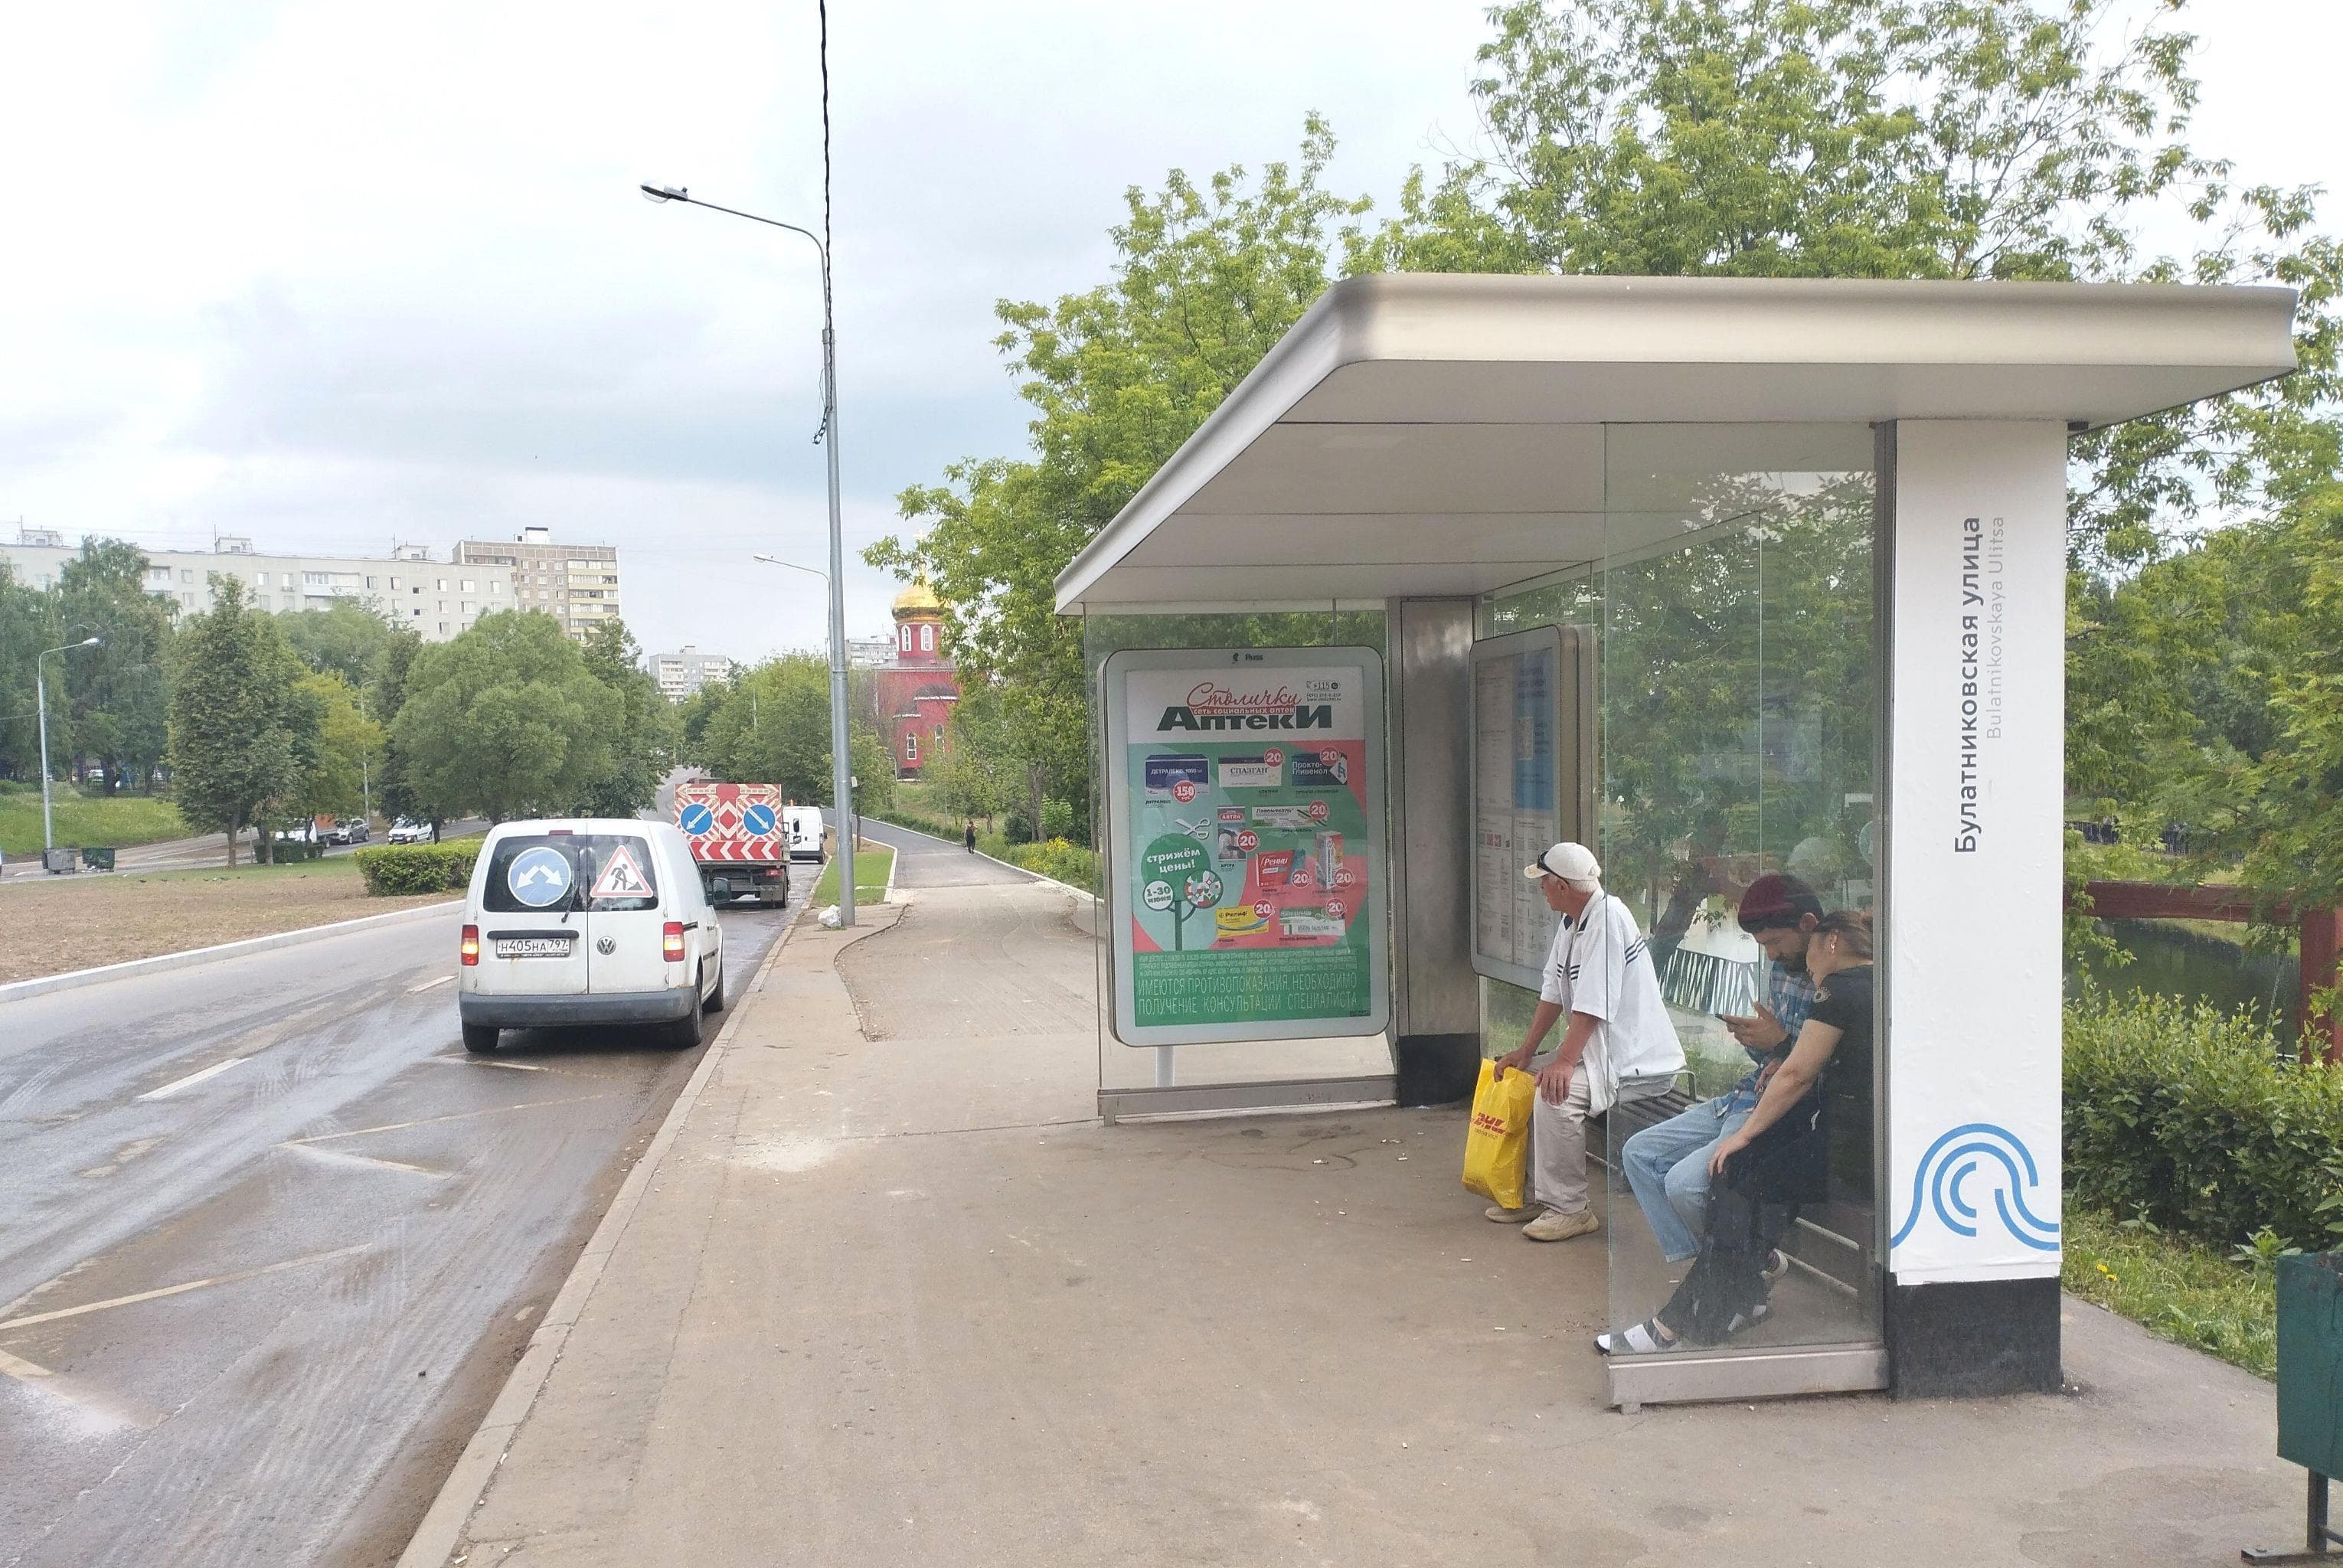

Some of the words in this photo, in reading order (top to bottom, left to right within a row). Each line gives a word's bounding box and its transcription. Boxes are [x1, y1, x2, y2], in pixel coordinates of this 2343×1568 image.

[1988, 517, 2004, 573] Ulitsa
[1962, 517, 1984, 606] улица
[1986, 580, 2006, 740] Bulatnikovskaya
[1187, 681, 1302, 707] Столички
[1955, 615, 1982, 853] Булатниковская
[1146, 848, 1201, 864] стрижём
[1159, 859, 1195, 874] цены!
[1147, 886, 1171, 897] 1-30
[1139, 978, 1185, 996] ИМЕЮТСЯ
[1292, 972, 1358, 991] НЕОБХОДИМО
[1139, 997, 1198, 1015] ПОЛУЧЕНИЕ
[1204, 995, 1281, 1013] КОНСУЛЬТАЦИИ
[1287, 991, 1358, 1011] СПЕЦИАЛИСТА
